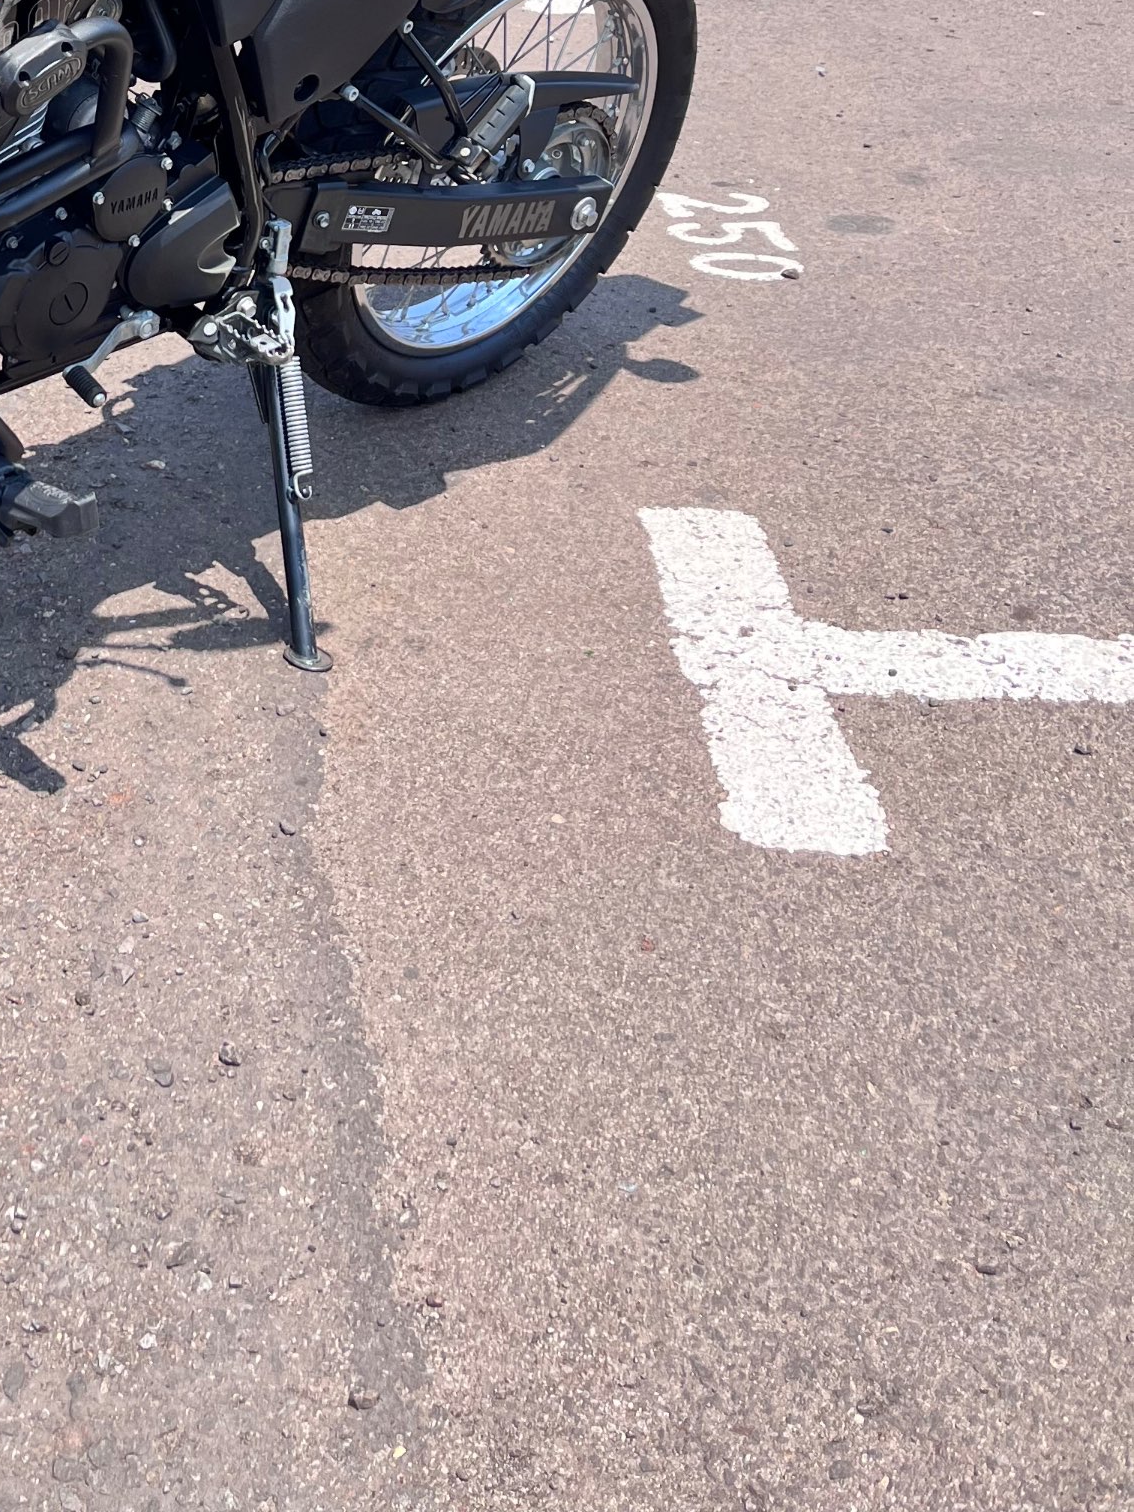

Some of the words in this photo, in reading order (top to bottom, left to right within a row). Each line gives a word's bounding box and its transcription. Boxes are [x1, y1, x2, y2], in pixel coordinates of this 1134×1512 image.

[110, 187, 158, 215] YAMAHA
[458, 200, 556, 239] YAMAHA
[656, 192, 804, 281] 250
